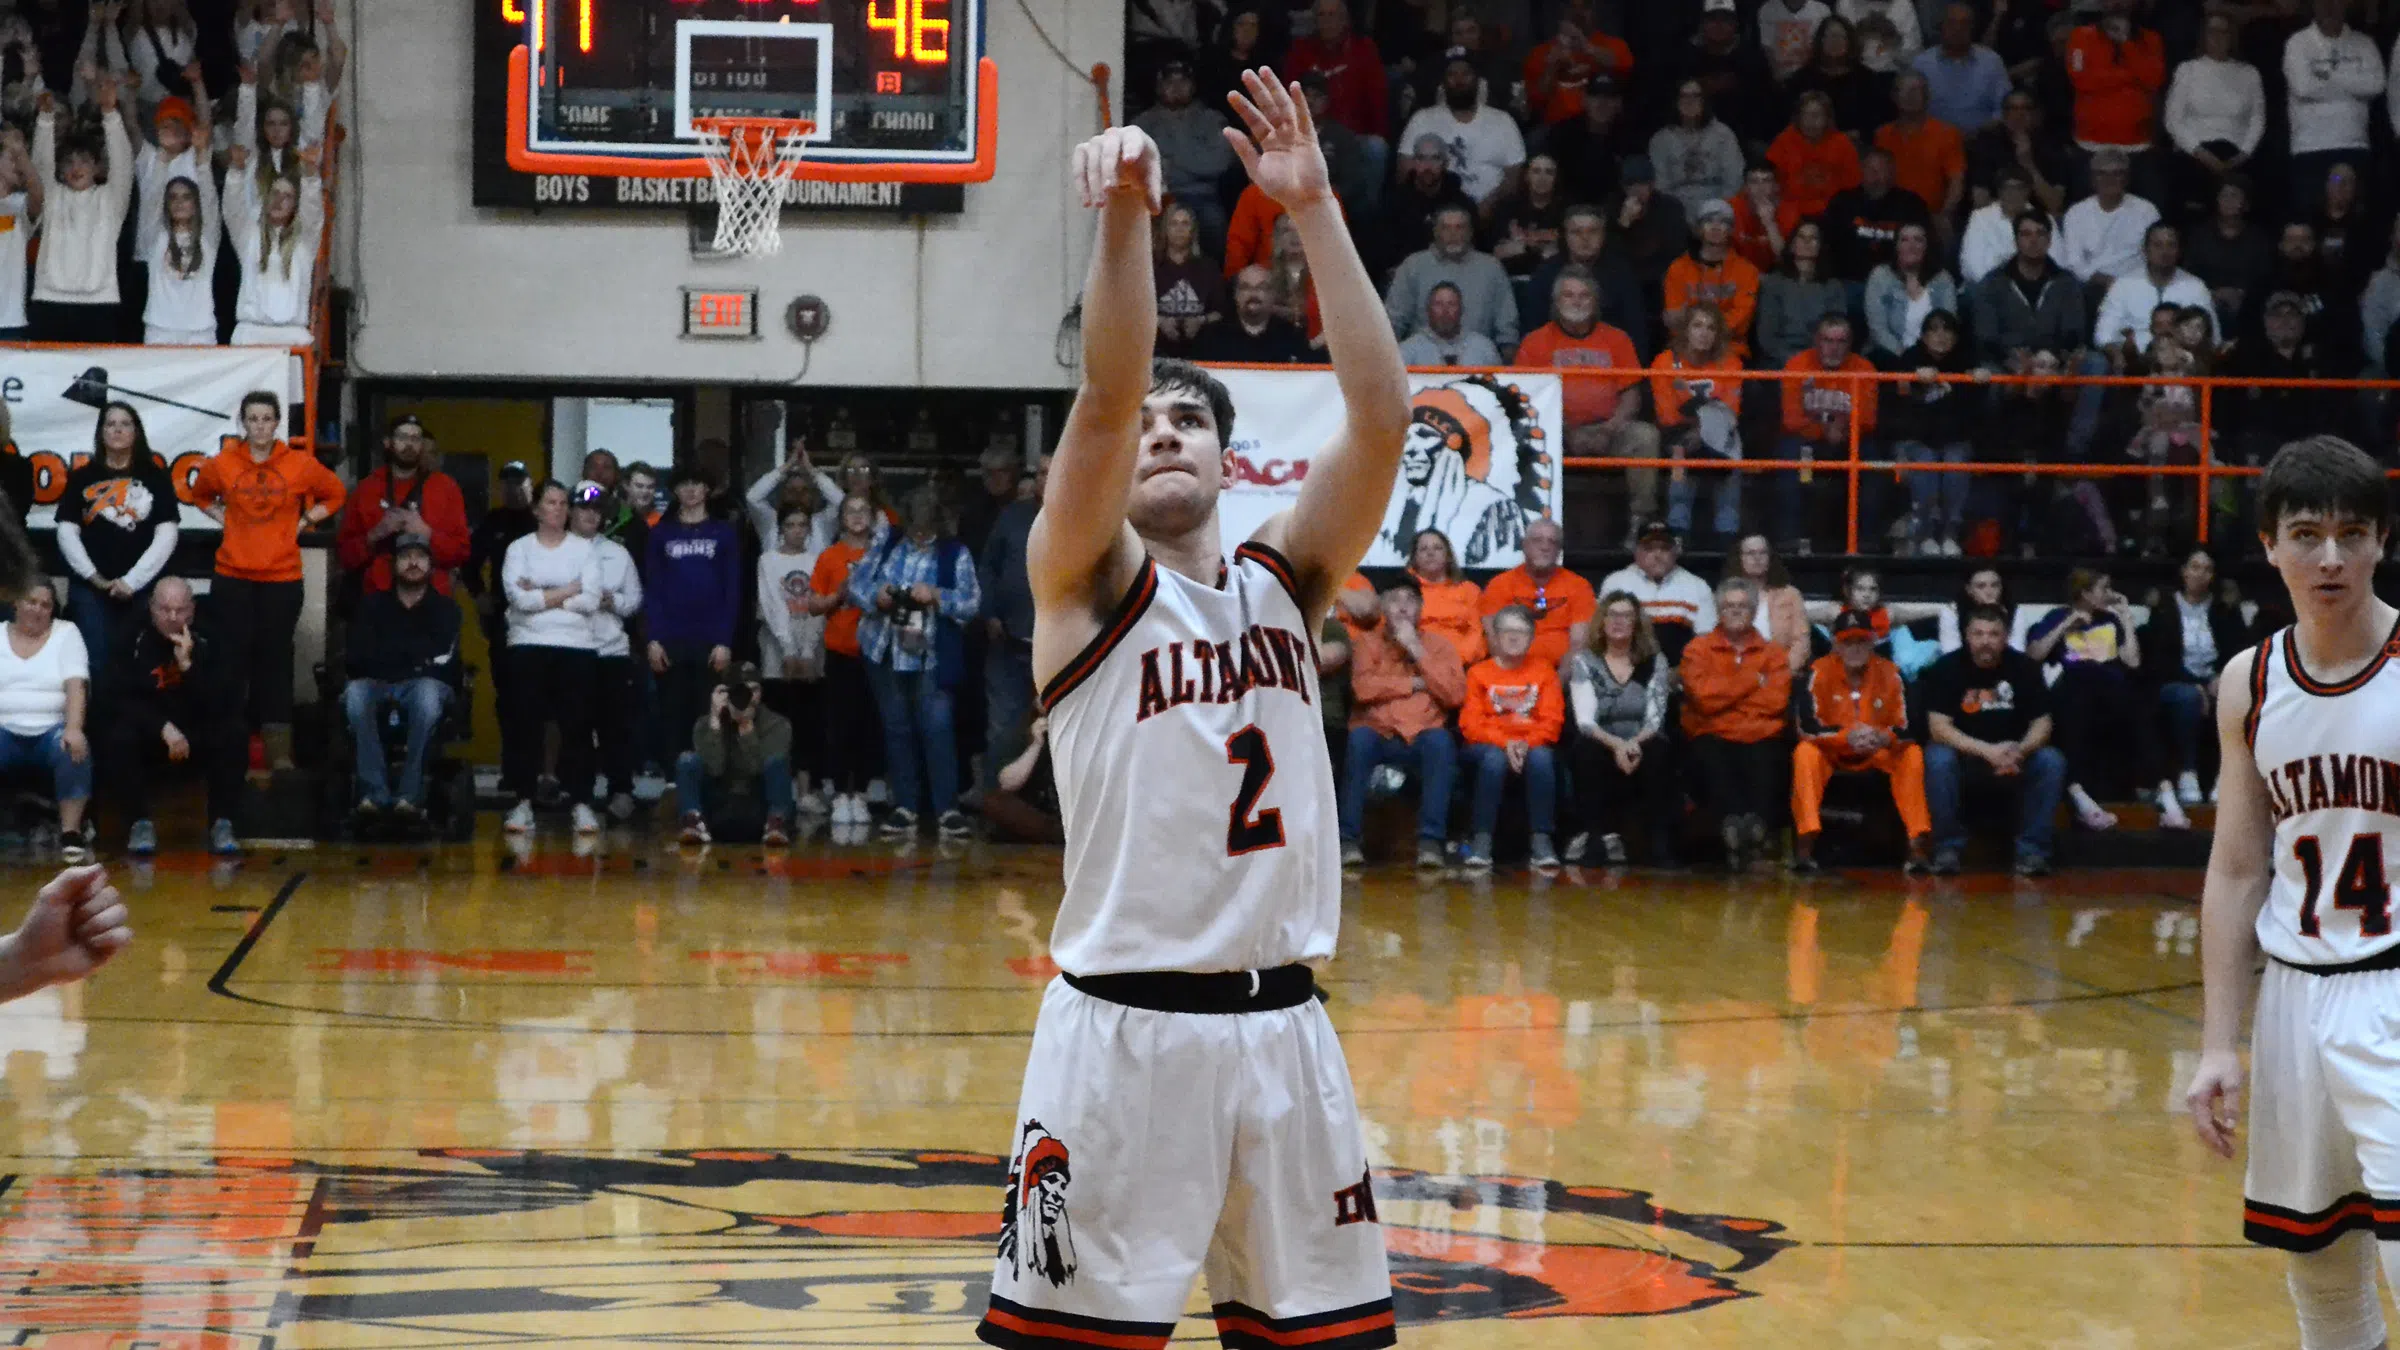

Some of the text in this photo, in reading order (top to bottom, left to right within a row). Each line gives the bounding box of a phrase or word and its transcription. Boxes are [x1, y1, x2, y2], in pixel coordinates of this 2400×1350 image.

[535, 175, 902, 206] BOYS BASKETBA OURNAMENT
[701, 294, 744, 326] EXIT
[1225, 722, 1287, 857] 2
[2293, 831, 2393, 939] 14
